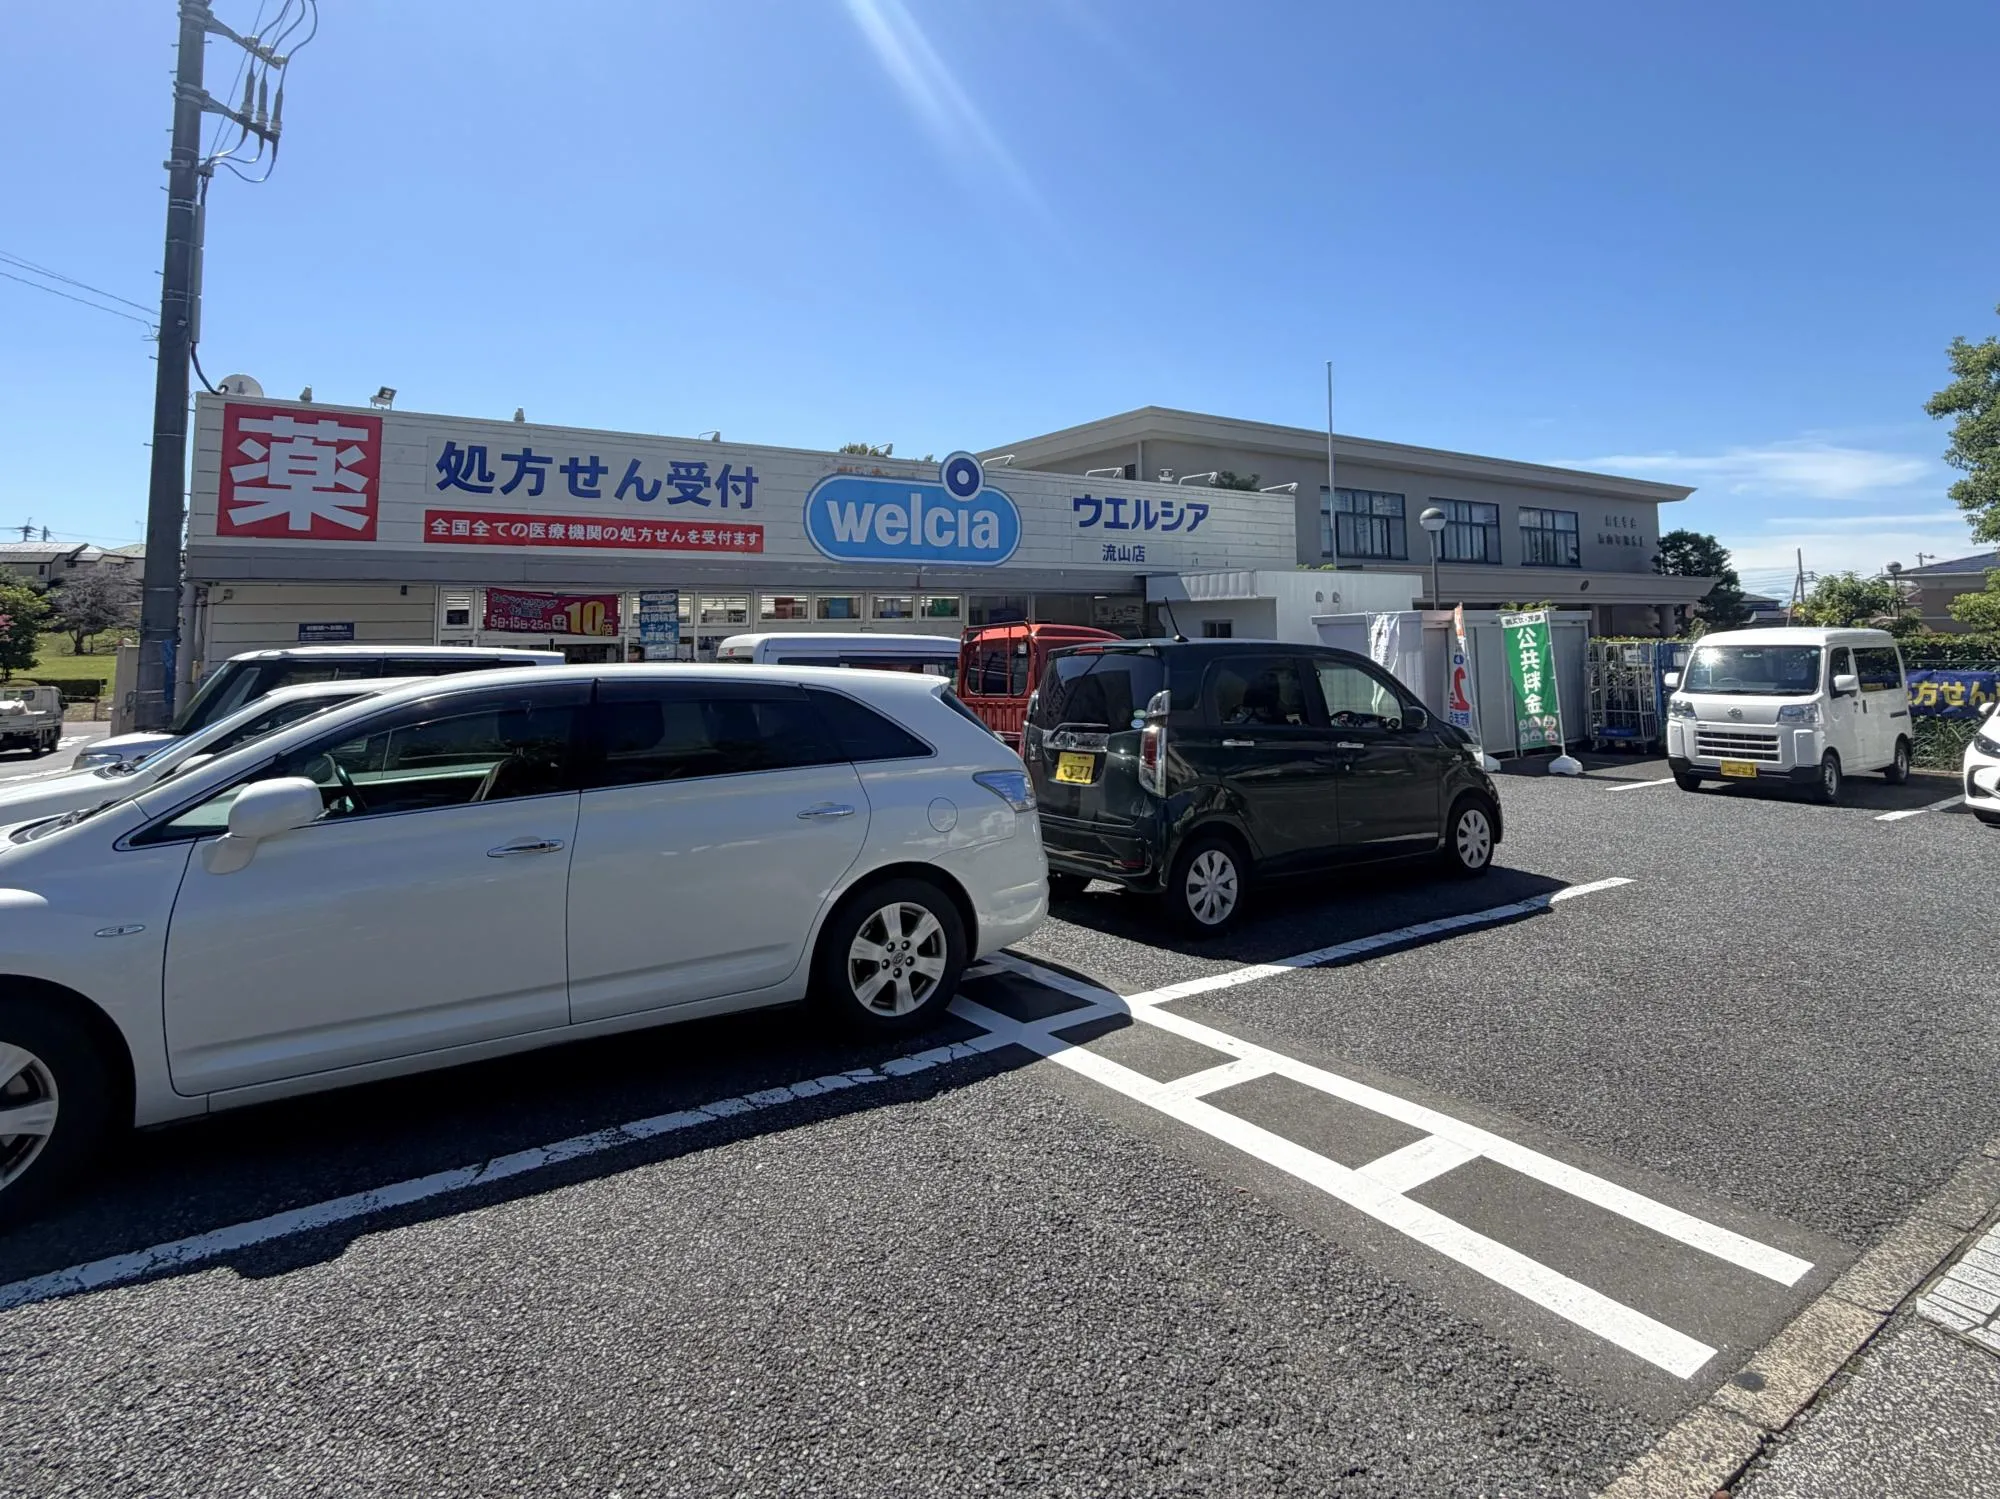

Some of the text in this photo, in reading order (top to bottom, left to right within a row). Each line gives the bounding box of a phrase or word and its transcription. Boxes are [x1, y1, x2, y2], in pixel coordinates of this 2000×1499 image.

[228, 415, 370, 532] 薬
[436, 440, 759, 510] 処方せん受付
[1072, 494, 1209, 533] ウエルシア
[430, 518, 760, 547] 全国全ての医療機関の処方せんを受付ます
[1101, 544, 1146, 564] 流山店
[1908, 680, 2000, 706] 方せん
